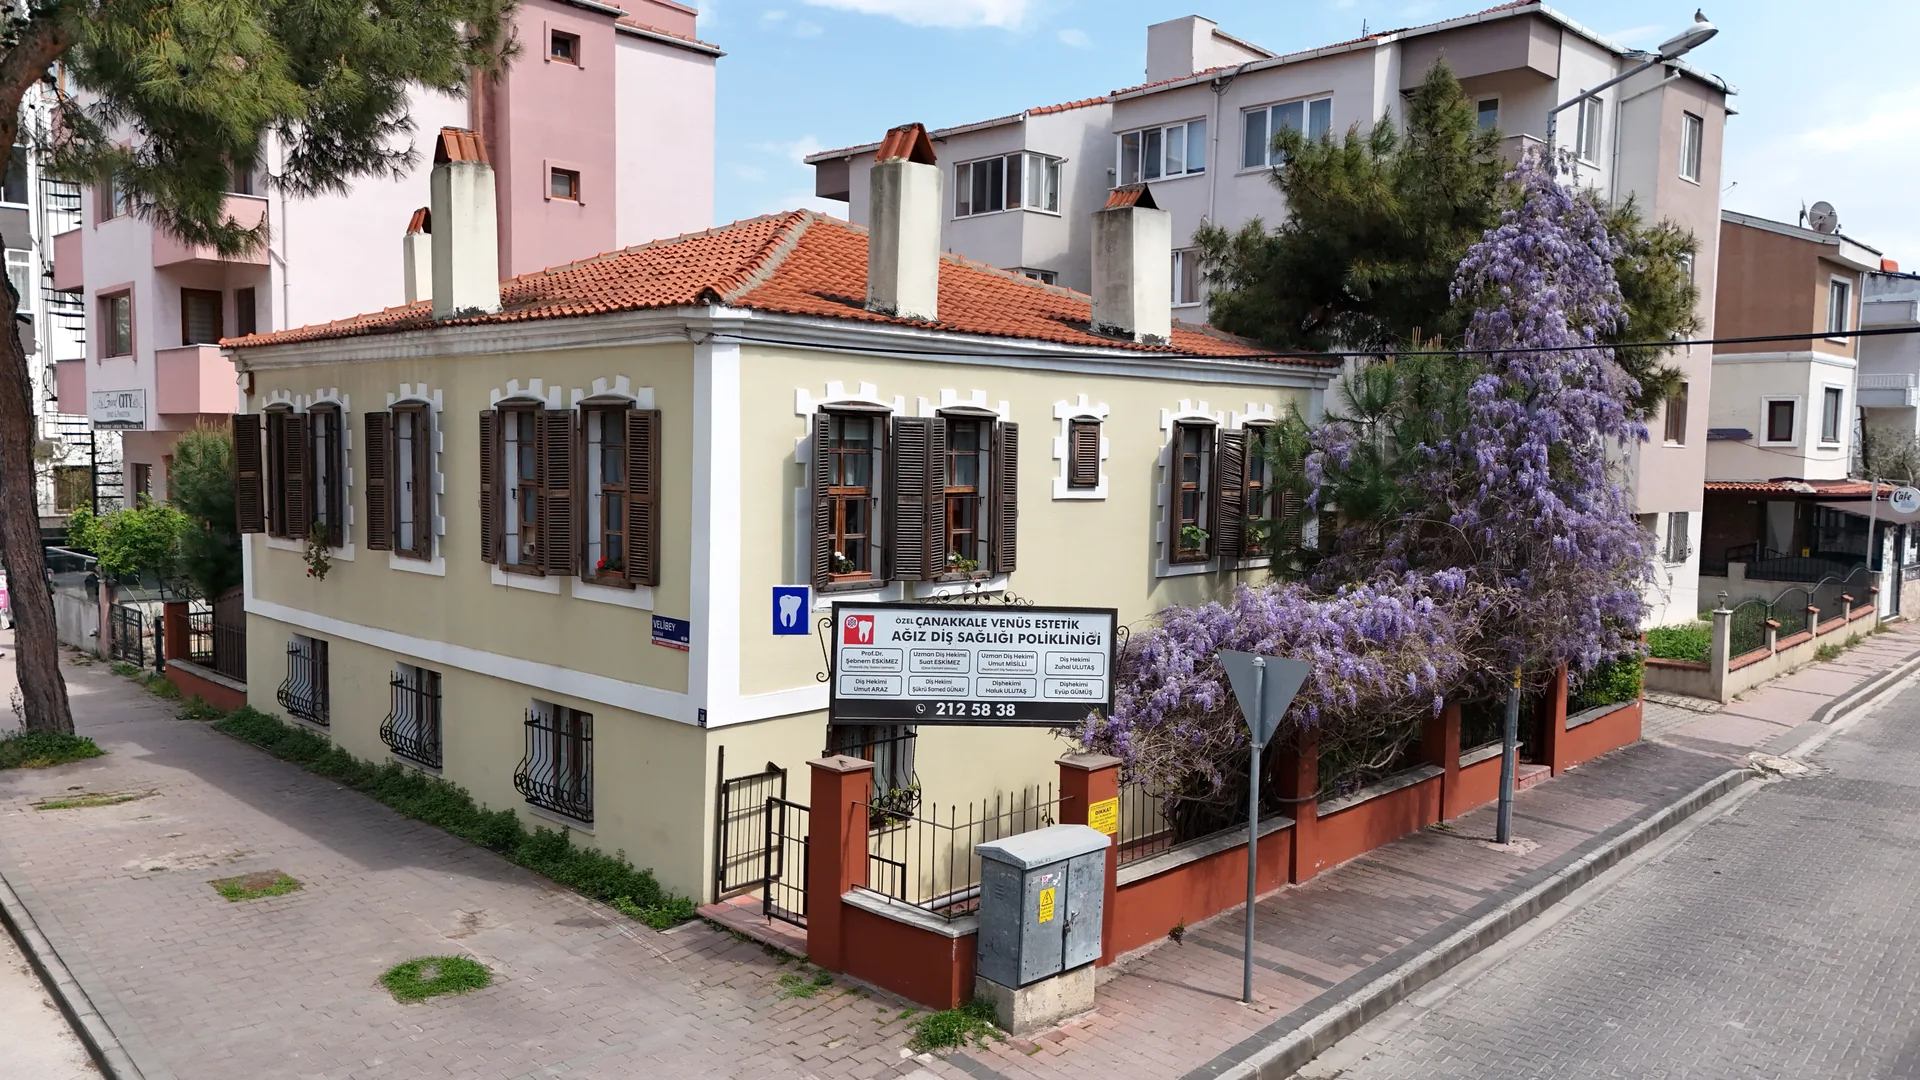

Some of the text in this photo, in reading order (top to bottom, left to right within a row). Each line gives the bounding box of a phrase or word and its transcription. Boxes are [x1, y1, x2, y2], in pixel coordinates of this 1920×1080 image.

[119, 393, 132, 408] CITY
[895, 616, 1080, 630] ÖZEL ÇANAKKALE VENÜS ESTETİK
[891, 628, 1102, 646] AĞIZ DİŞ SAĞLIĞI POLİKLİNİĞİ
[853, 686, 871, 694] Umut
[985, 687, 1027, 696] Haluk ULUTAŞ
[1054, 688, 1093, 697] Eyüp GÜMÜŞ
[935, 702, 1016, 717] 212 58 38
